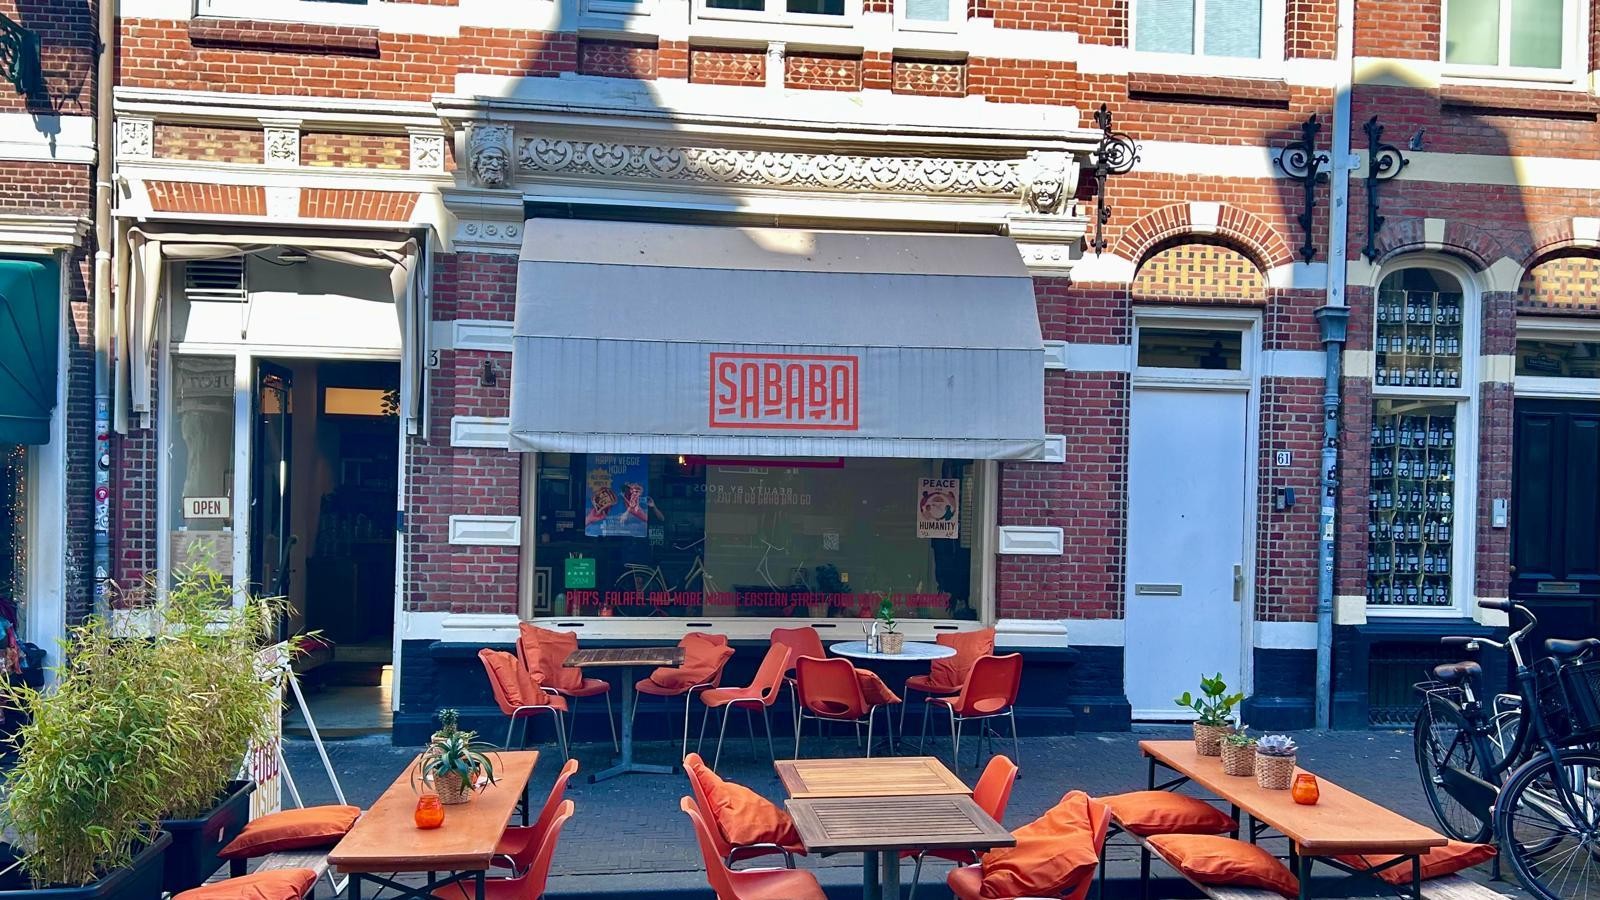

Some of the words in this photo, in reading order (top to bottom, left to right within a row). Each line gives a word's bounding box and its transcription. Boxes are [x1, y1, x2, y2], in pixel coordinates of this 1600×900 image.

[719, 362, 850, 421] SABABA
[595, 456, 617, 465] HAPPY
[617, 457, 641, 466] VEGGIE
[1278, 453, 1289, 465] 61
[608, 465, 627, 474] HOUR
[923, 480, 955, 488] PEACE
[193, 501, 221, 515] OPEN
[920, 521, 956, 531] HUMANITY
[605, 591, 646, 606] FALAFEL
[674, 592, 702, 606] MORE
